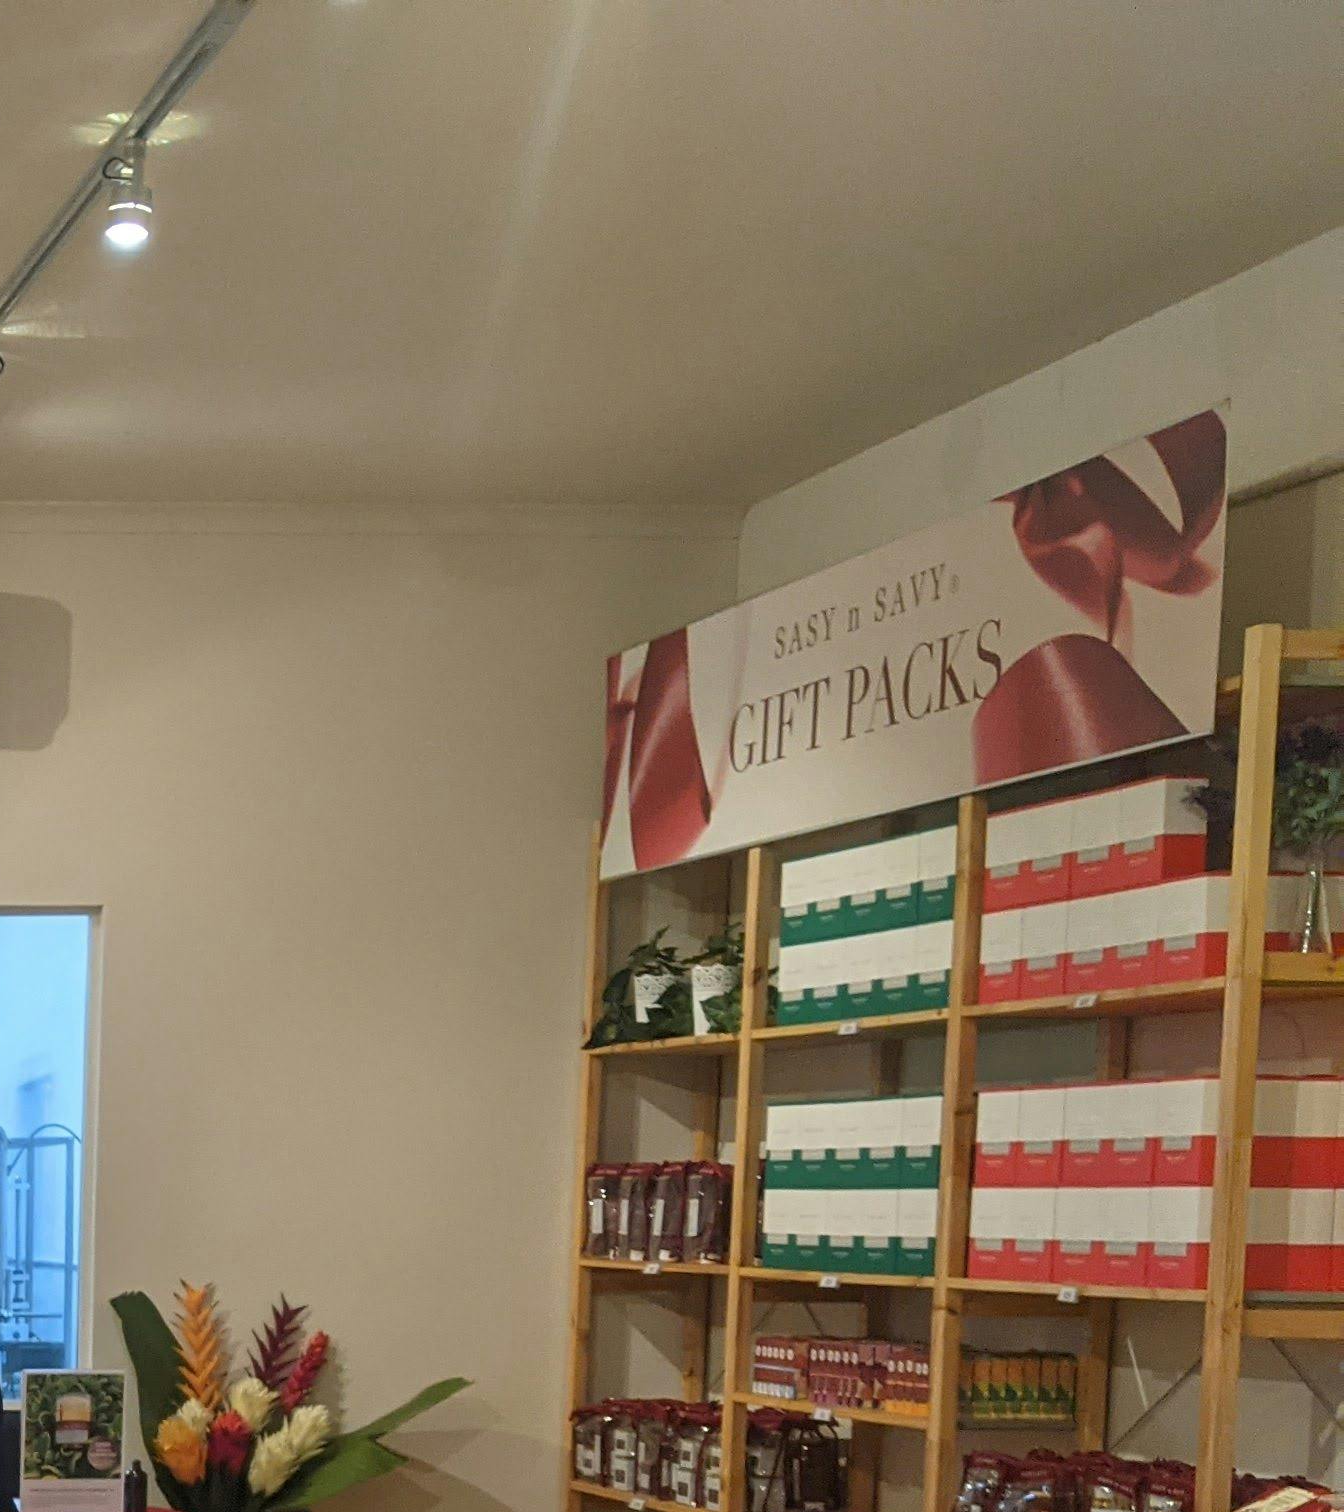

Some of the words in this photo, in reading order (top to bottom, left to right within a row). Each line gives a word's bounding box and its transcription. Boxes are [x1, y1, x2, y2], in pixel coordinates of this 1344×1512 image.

[773, 606, 837, 660] SASY
[728, 677, 830, 774] GIFT
[841, 618, 1005, 741] PACKS
